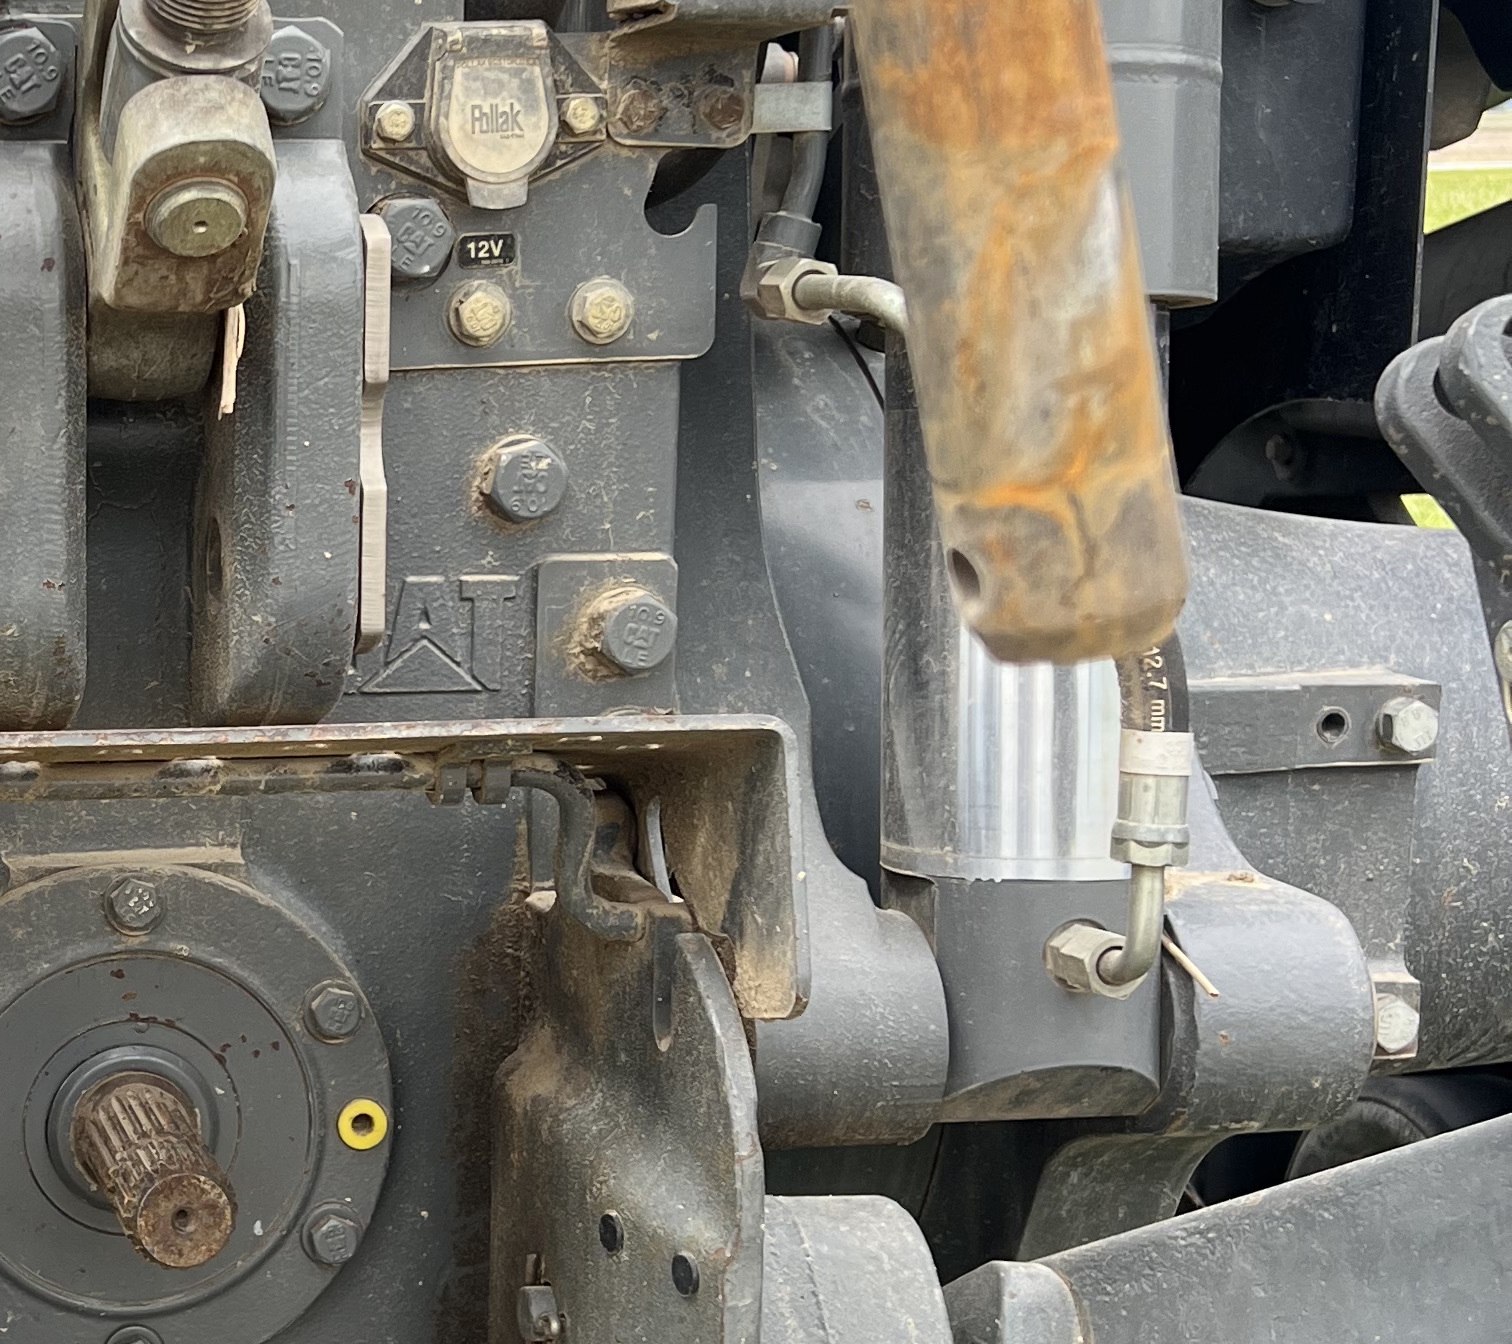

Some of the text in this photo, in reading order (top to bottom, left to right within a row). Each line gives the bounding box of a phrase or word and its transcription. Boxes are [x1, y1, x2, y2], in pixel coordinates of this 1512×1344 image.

[27, 39, 59, 82] 10.9
[471, 101, 524, 135] Pollak
[467, 239, 504, 259] 12V
[628, 604, 666, 625] 10.9
[623, 622, 662, 651] CAT
[1143, 646, 1168, 690] 12.7
